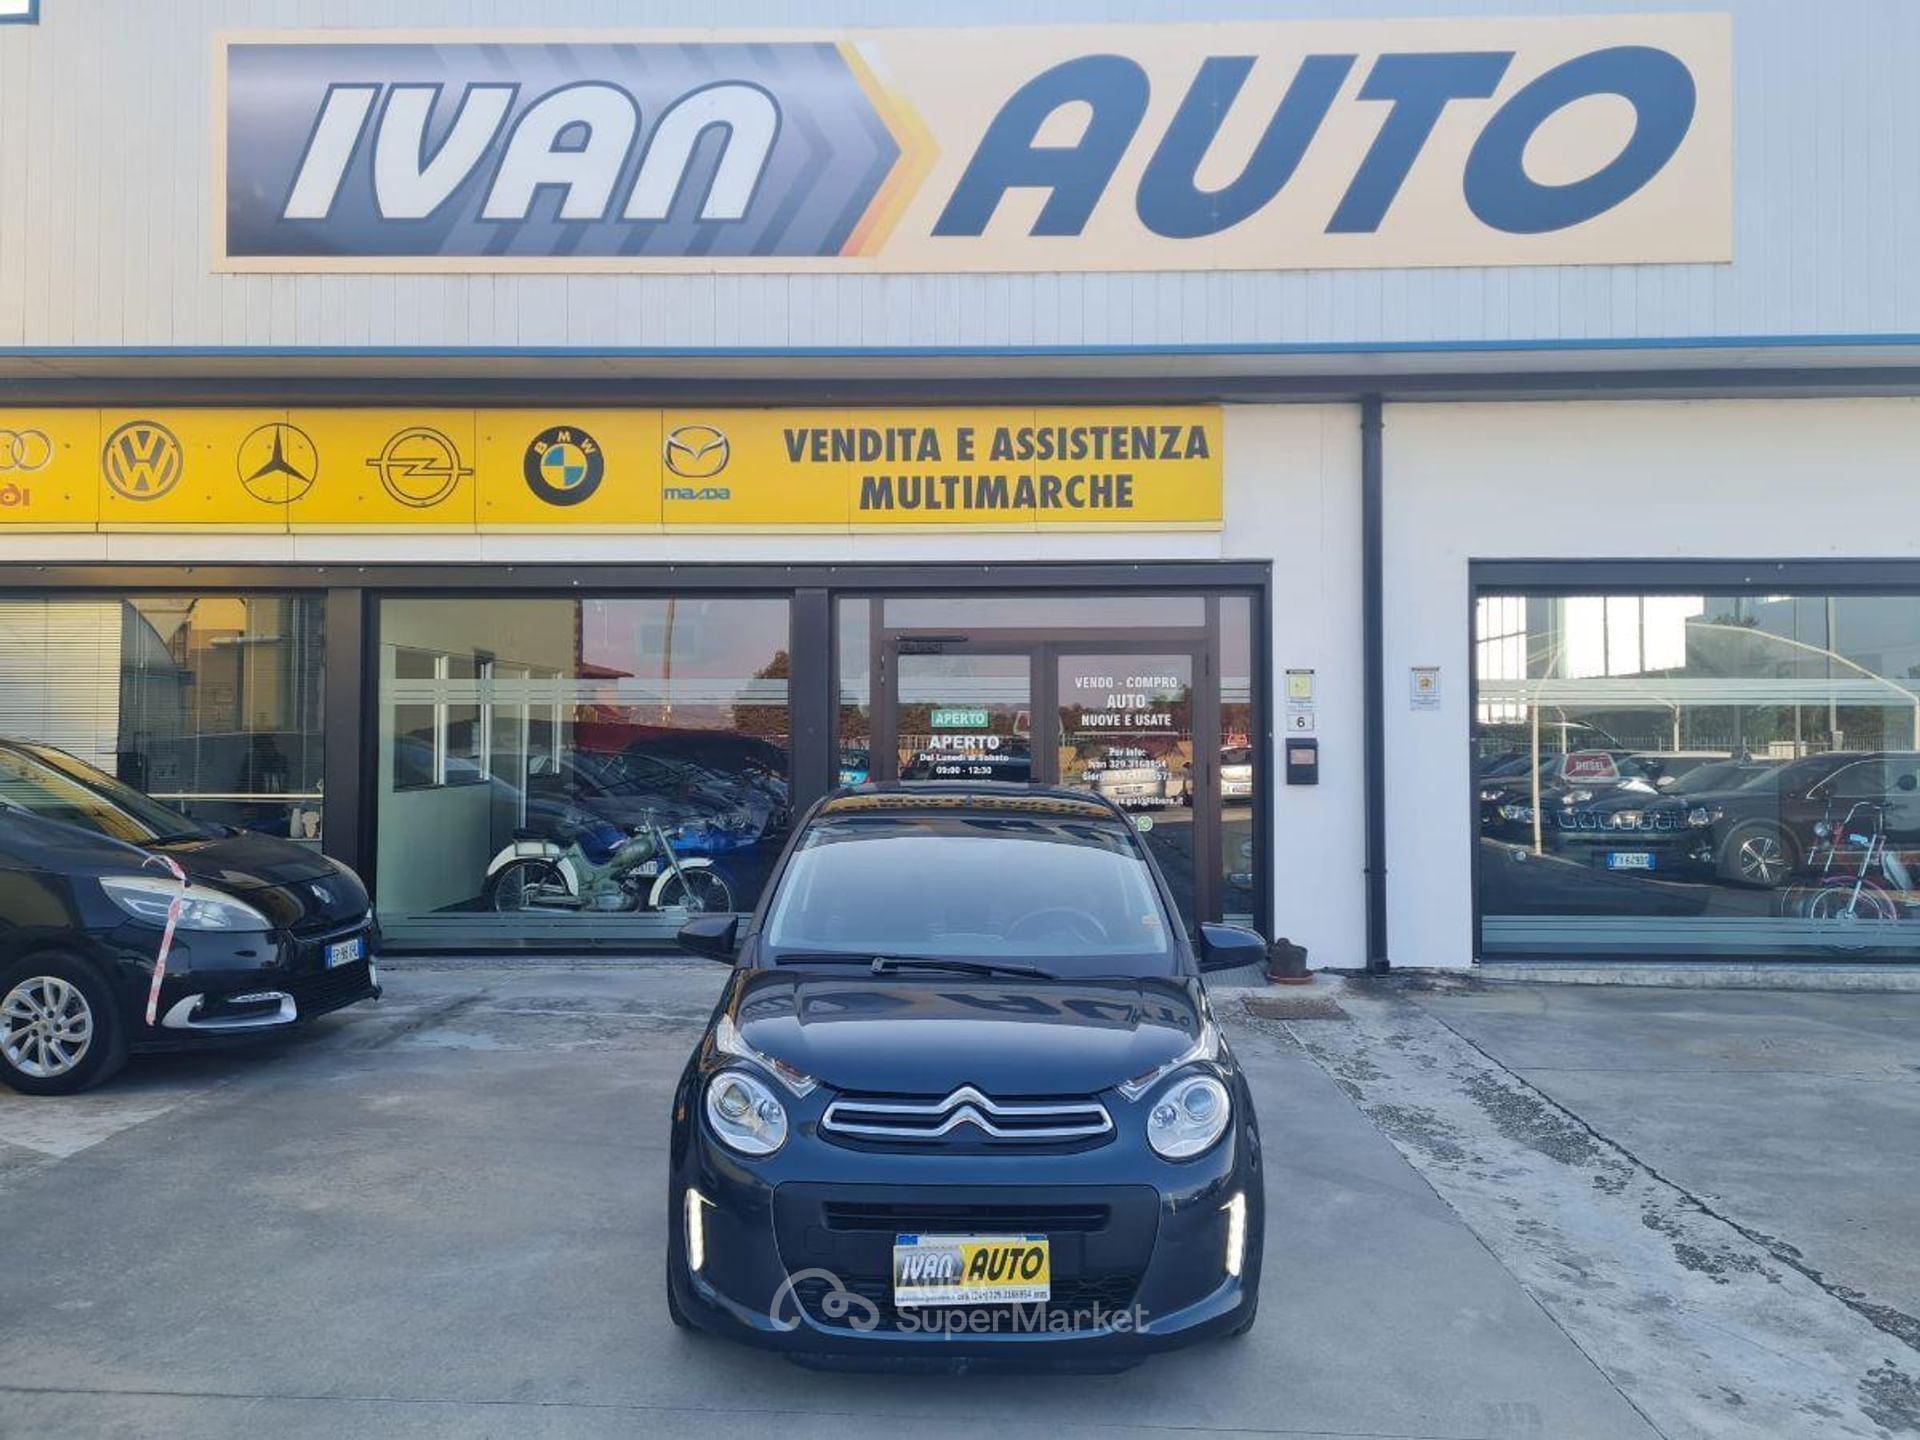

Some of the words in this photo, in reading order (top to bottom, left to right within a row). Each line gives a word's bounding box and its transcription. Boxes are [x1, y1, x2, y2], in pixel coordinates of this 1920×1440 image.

[278, 80, 781, 224] IVAN
[930, 46, 1697, 239] AUTO
[534, 431, 596, 455] BMW
[784, 429, 941, 462] VENDITA
[957, 428, 974, 461] E
[990, 426, 1210, 461] ASSISTENZA
[860, 474, 1133, 510] MULTIMARCHE
[1075, 677, 1113, 688] VENDO
[1126, 676, 1177, 688] COMPRO
[1107, 694, 1145, 708] AUTO
[935, 713, 985, 725] APERTO
[1081, 714, 1120, 726] NUOVE
[1125, 714, 1131, 726] E
[1135, 714, 1172, 726] USATE
[1296, 716, 1306, 728] 6
[930, 735, 1000, 750] APERTO
[901, 1253, 952, 1280] IVAN
[968, 1247, 1044, 1281] AUTO
